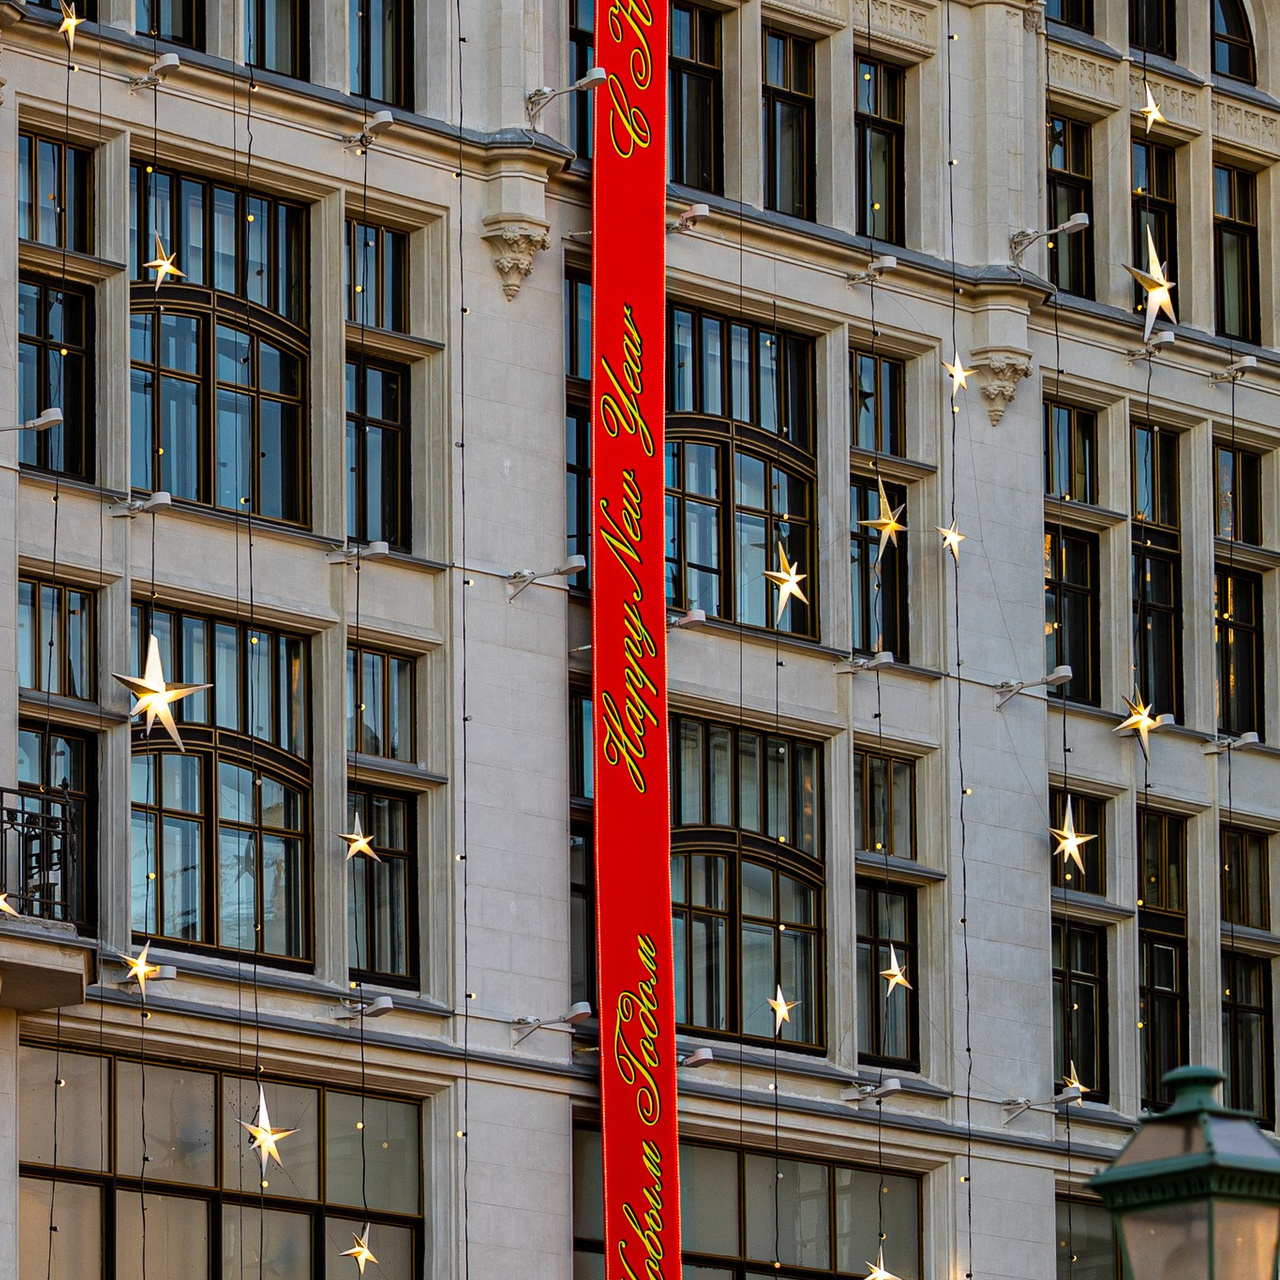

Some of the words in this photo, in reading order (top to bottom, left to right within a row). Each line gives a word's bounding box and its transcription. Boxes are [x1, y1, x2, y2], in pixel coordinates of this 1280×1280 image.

[610, 72, 651, 159] С
[601, 302, 655, 458] Year
[600, 468, 643, 602] New
[602, 602, 658, 794] Happy
[614, 933, 661, 1127] Годом
